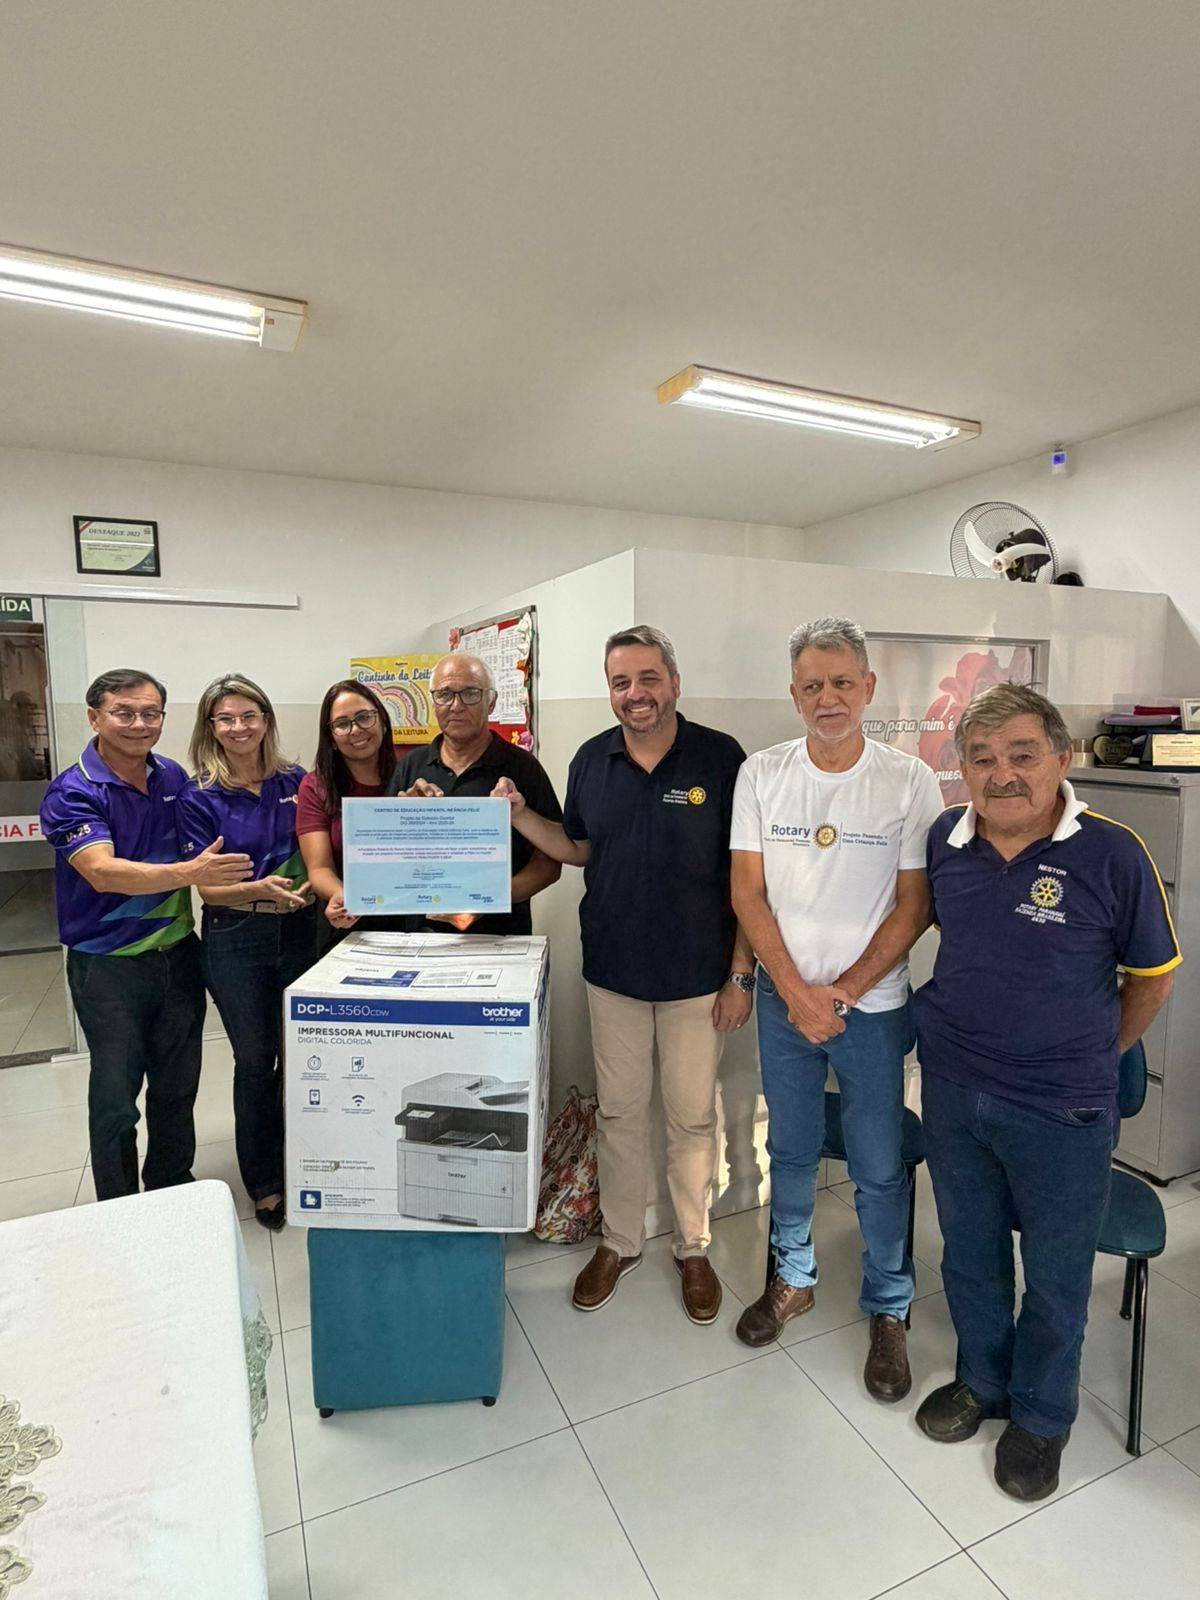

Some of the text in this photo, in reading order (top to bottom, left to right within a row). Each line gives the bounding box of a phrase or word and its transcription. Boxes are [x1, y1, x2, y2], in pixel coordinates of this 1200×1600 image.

[88, 528, 125, 536] DESTAQUE
[0, 596, 30, 612] ÍDA
[358, 670, 395, 682] Cantinho
[862, 716, 955, 741] que para mim é
[0, 823, 39, 837] IA F
[771, 824, 811, 838] Rotary
[1037, 863, 1068, 876] NESTOR
[297, 1003, 390, 1017] DCP-L3560CDW
[482, 1007, 524, 1017] brother
[298, 1027, 455, 1039] IMPRESSORA MULTIFUNCIONAL
[330, 1037, 372, 1045] COLORIDA
